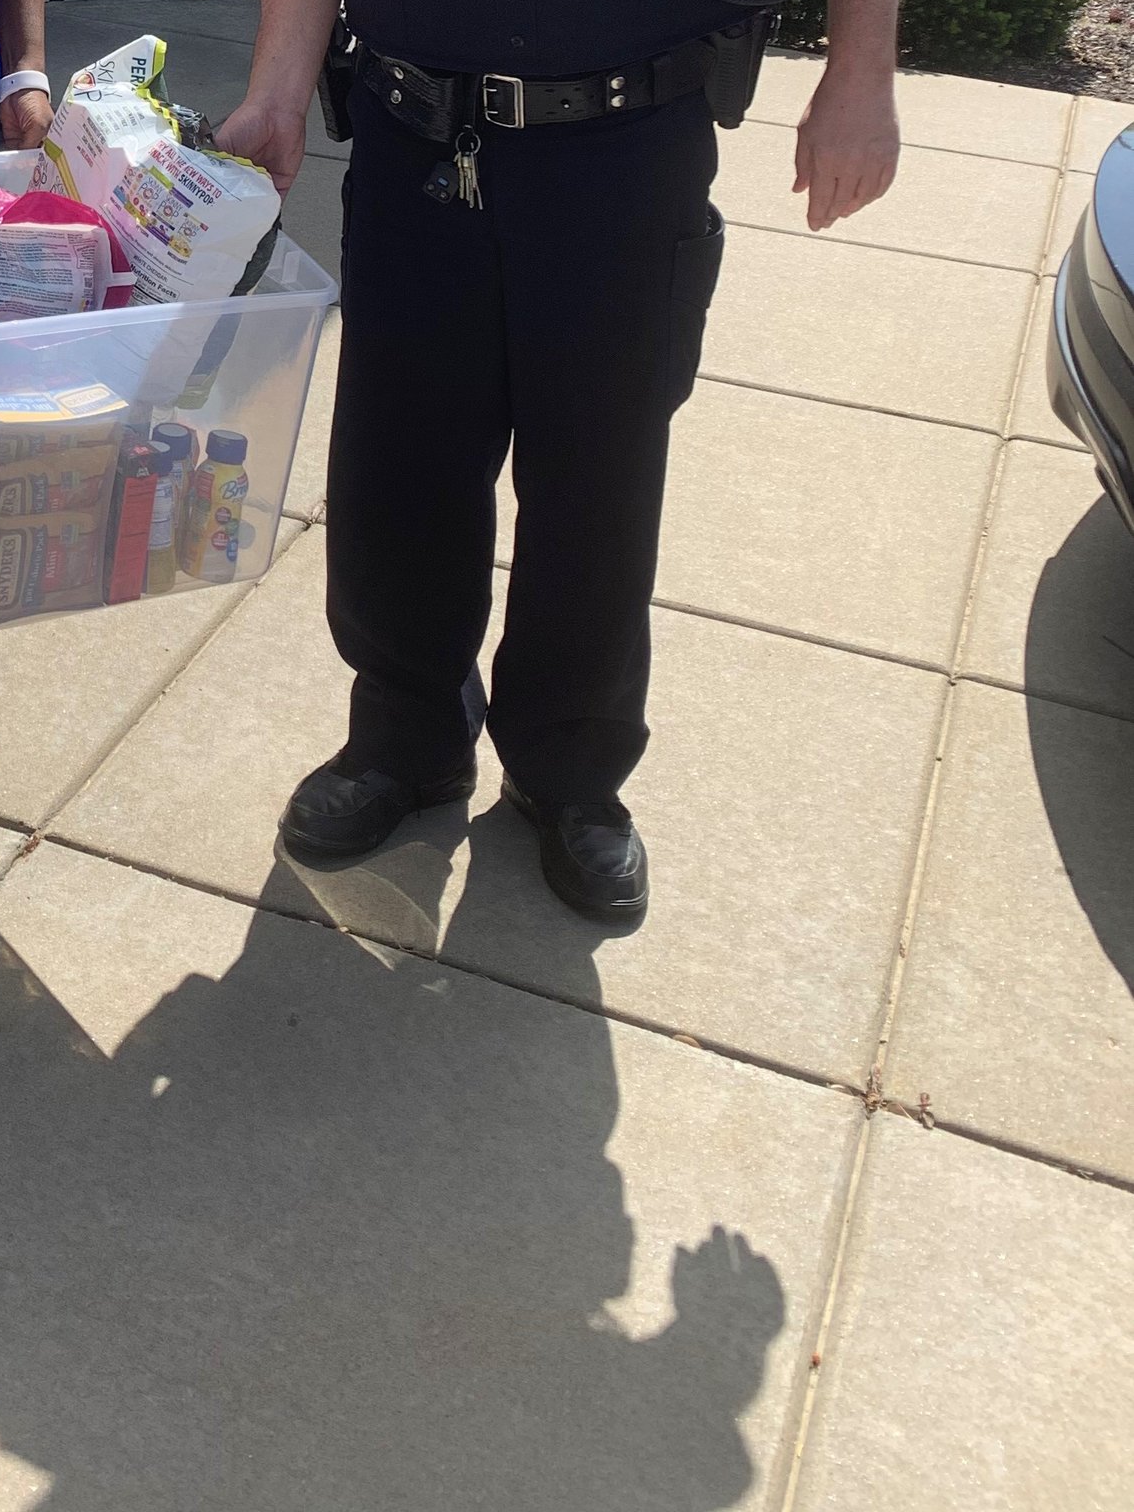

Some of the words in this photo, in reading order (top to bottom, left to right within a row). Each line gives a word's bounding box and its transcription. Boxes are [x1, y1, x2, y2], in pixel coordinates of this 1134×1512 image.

[130, 56, 147, 91] PER
[165, 148, 177, 160] ALL
[196, 174, 215, 192] WAYS
[212, 187, 222, 199] TO
[166, 162, 182, 180] WITH
[131, 263, 157, 287] Nutrition
[157, 283, 177, 299] Facts
[45, 551, 57, 579] Mini
